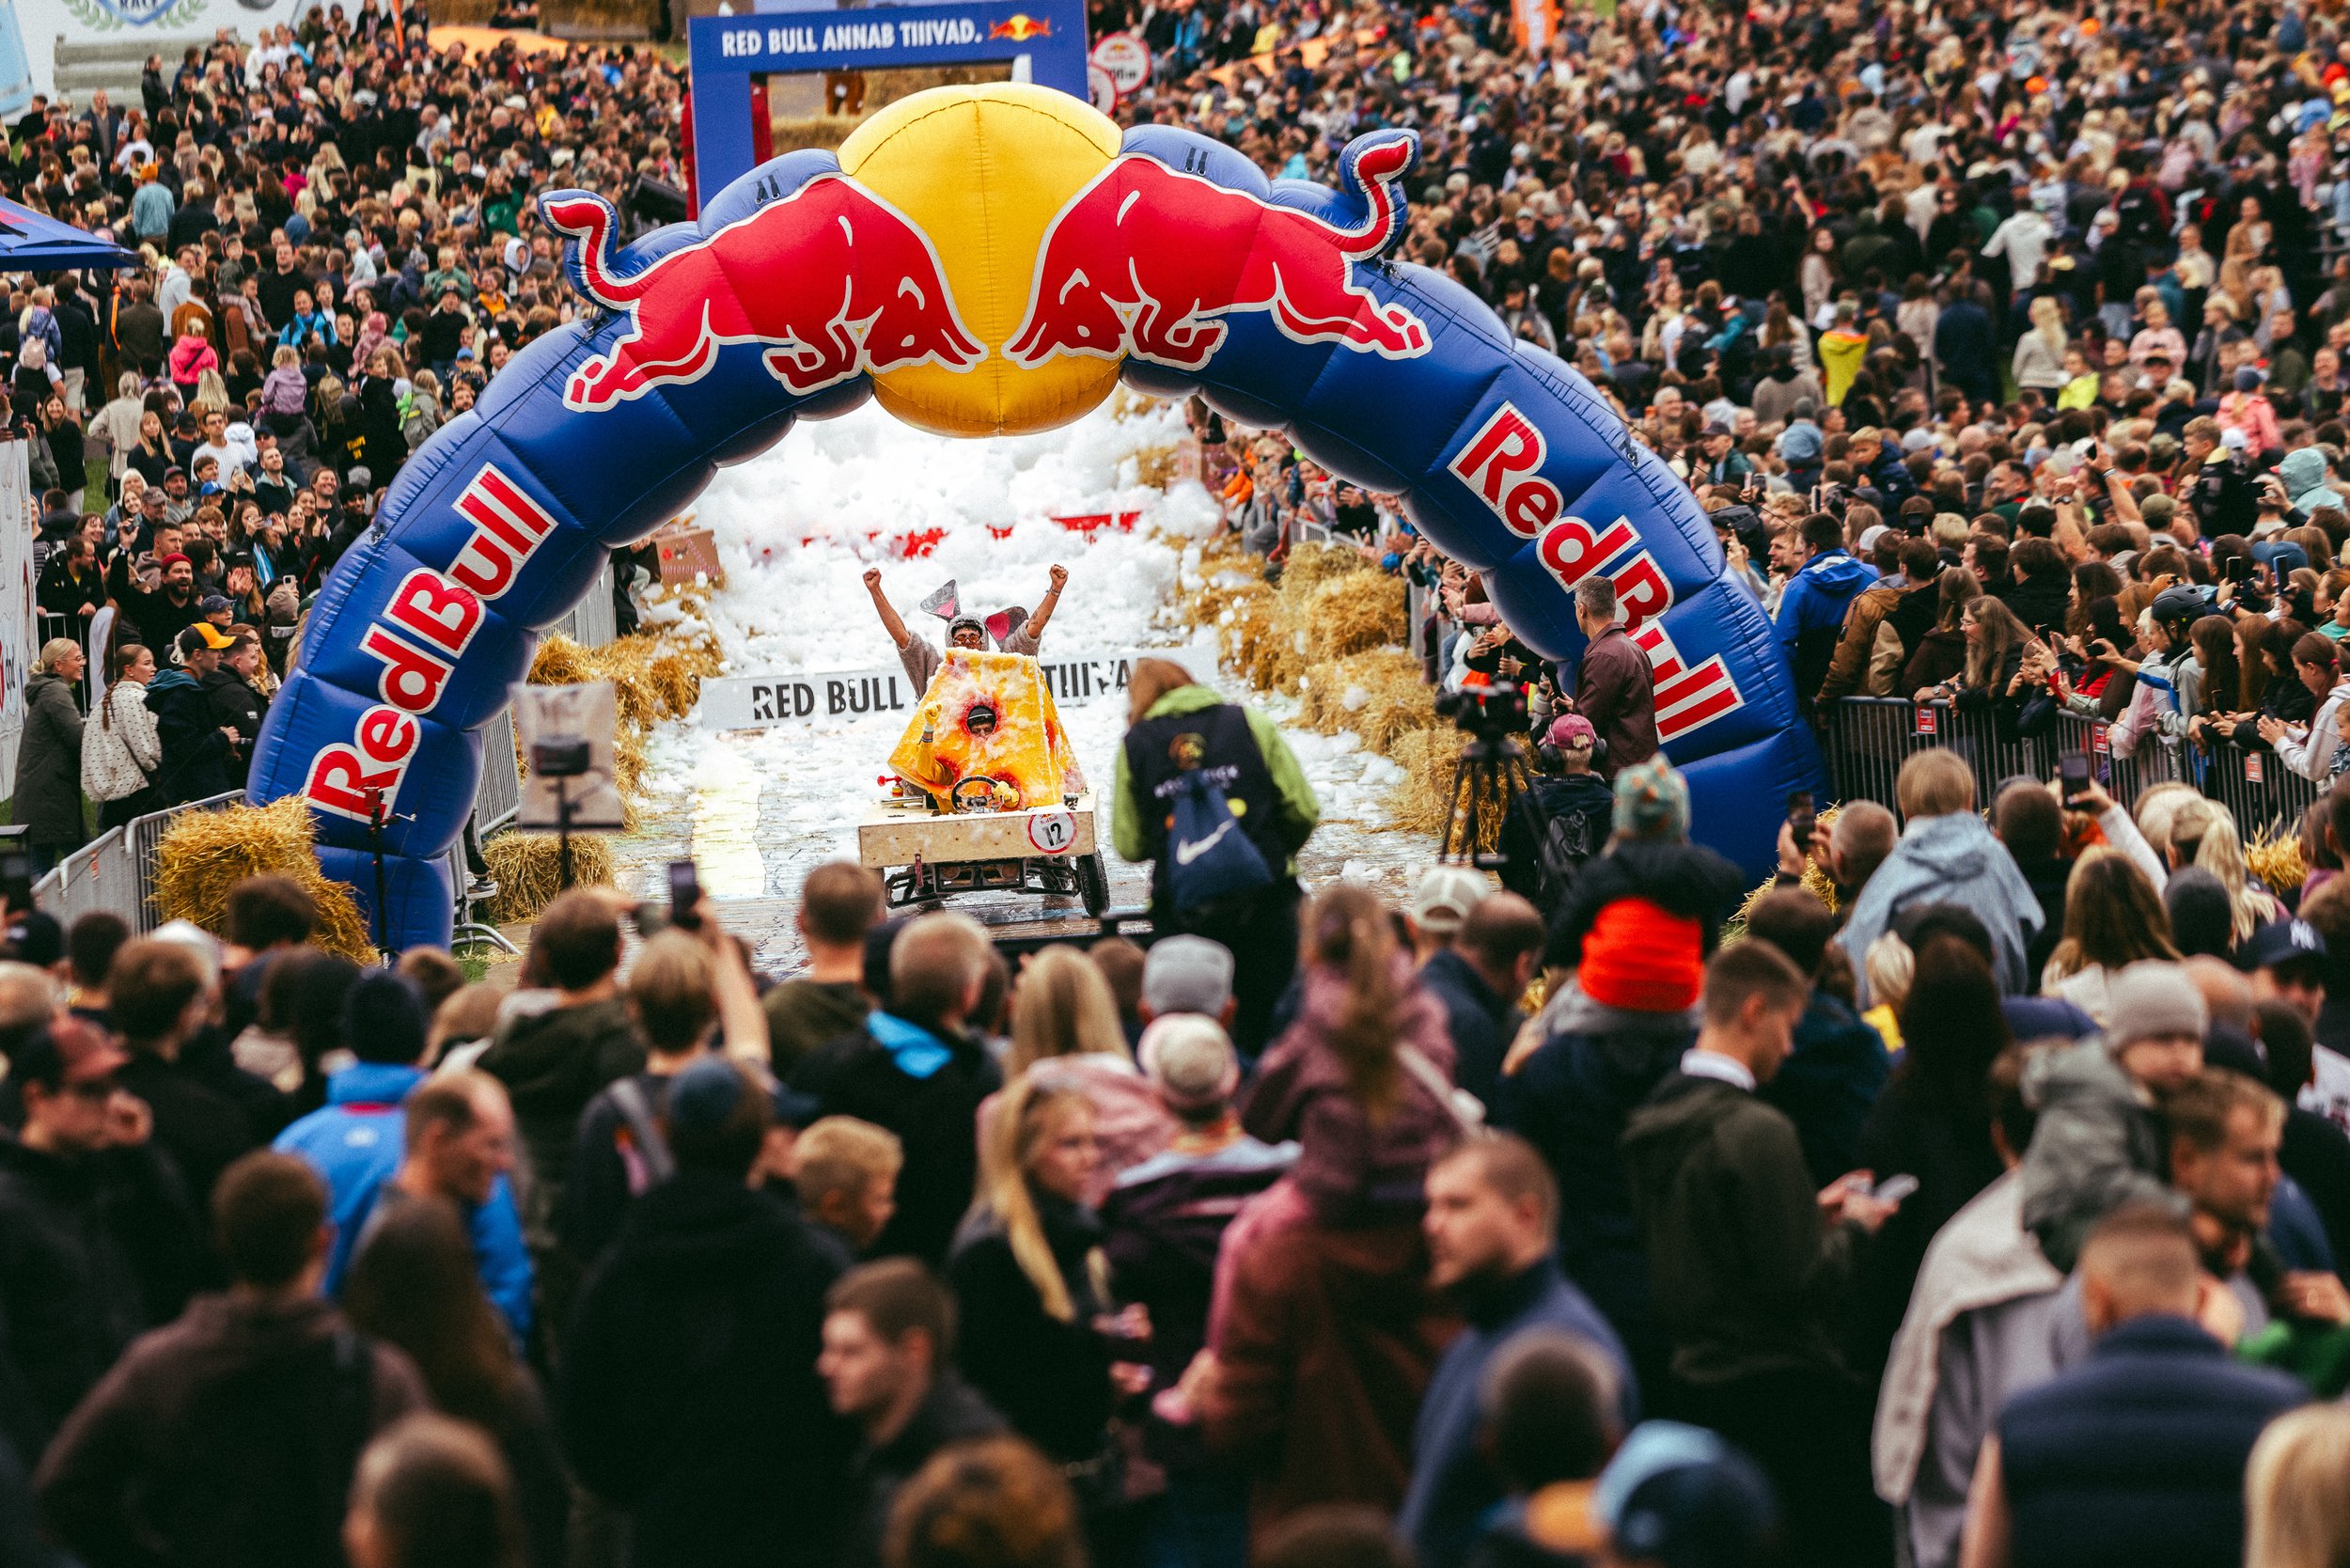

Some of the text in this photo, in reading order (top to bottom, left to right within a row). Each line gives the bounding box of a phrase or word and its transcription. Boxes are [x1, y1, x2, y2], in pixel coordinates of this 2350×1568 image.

[722, 31, 762, 56] RED
[768, 26, 818, 55] BULL
[822, 22, 895, 52] ANNAB
[752, 683, 815, 720] RED
[827, 676, 904, 714] BULL
[1042, 823, 1066, 847] 12
